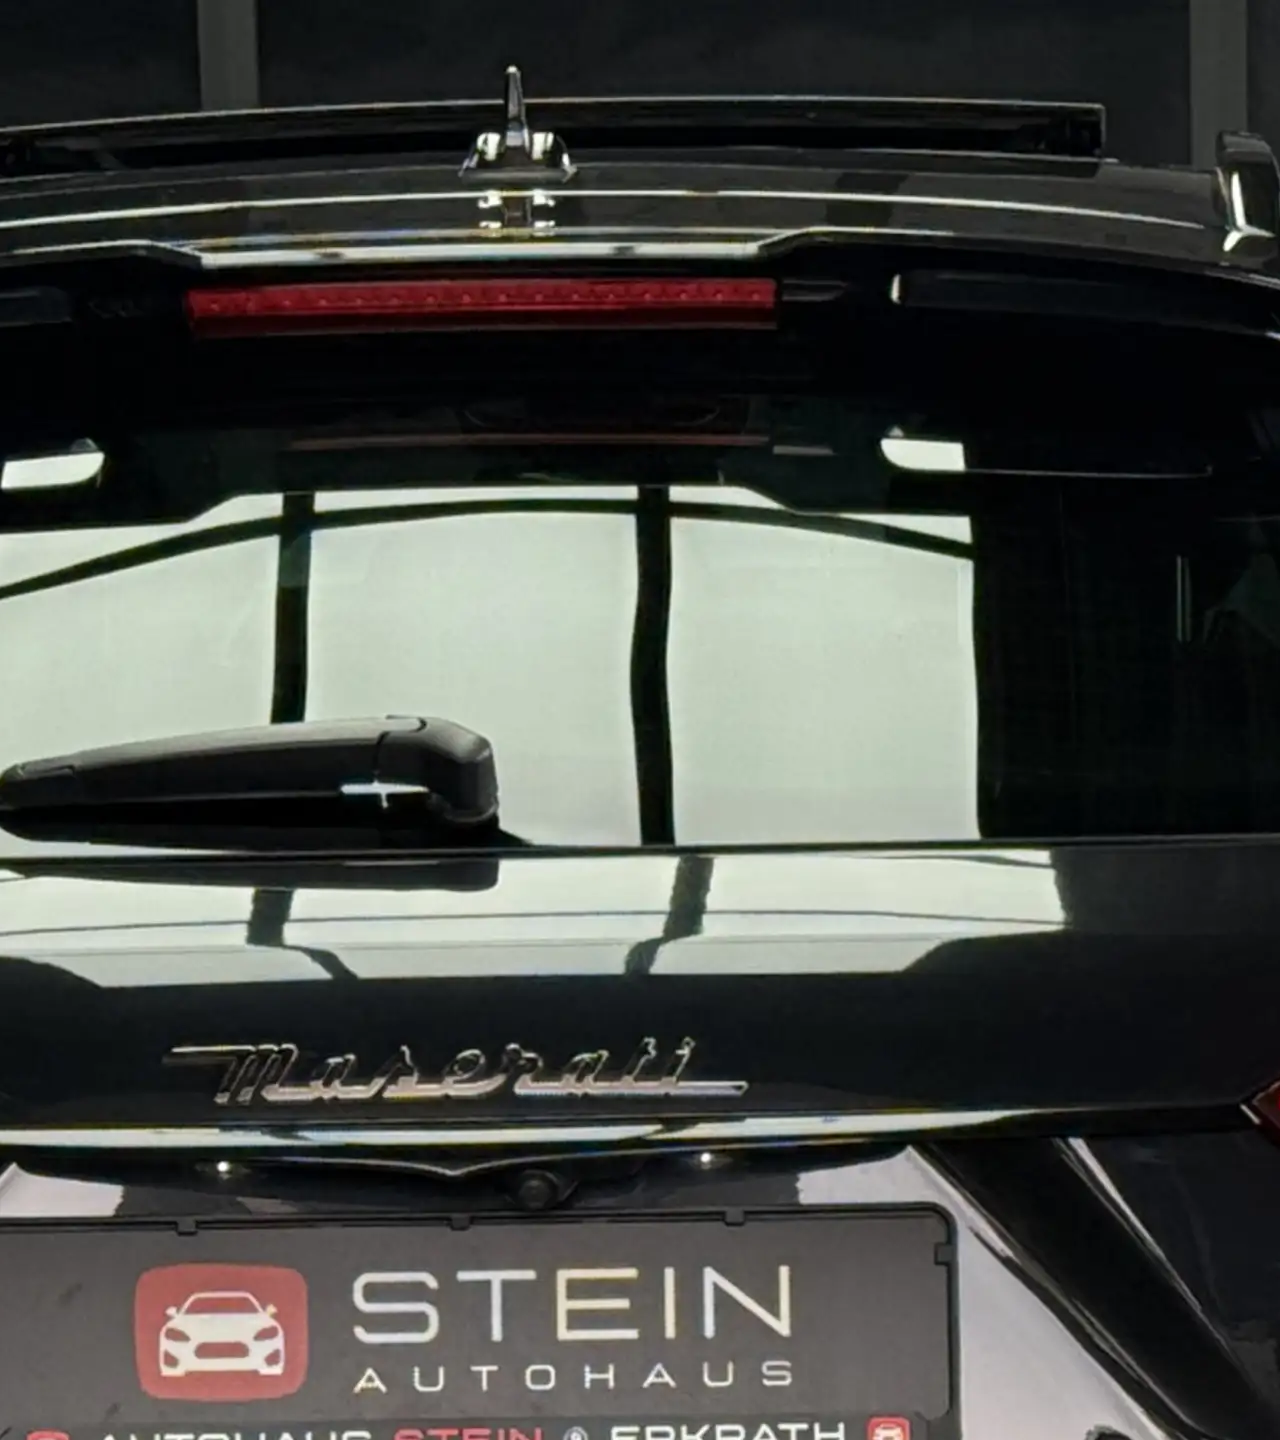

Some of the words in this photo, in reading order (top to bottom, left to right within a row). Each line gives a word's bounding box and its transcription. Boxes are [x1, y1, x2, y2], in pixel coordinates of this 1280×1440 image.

[166, 1037, 749, 1103] Maserati
[352, 1264, 792, 1344] STEIN
[353, 1359, 793, 1394] AUTOHAUS
